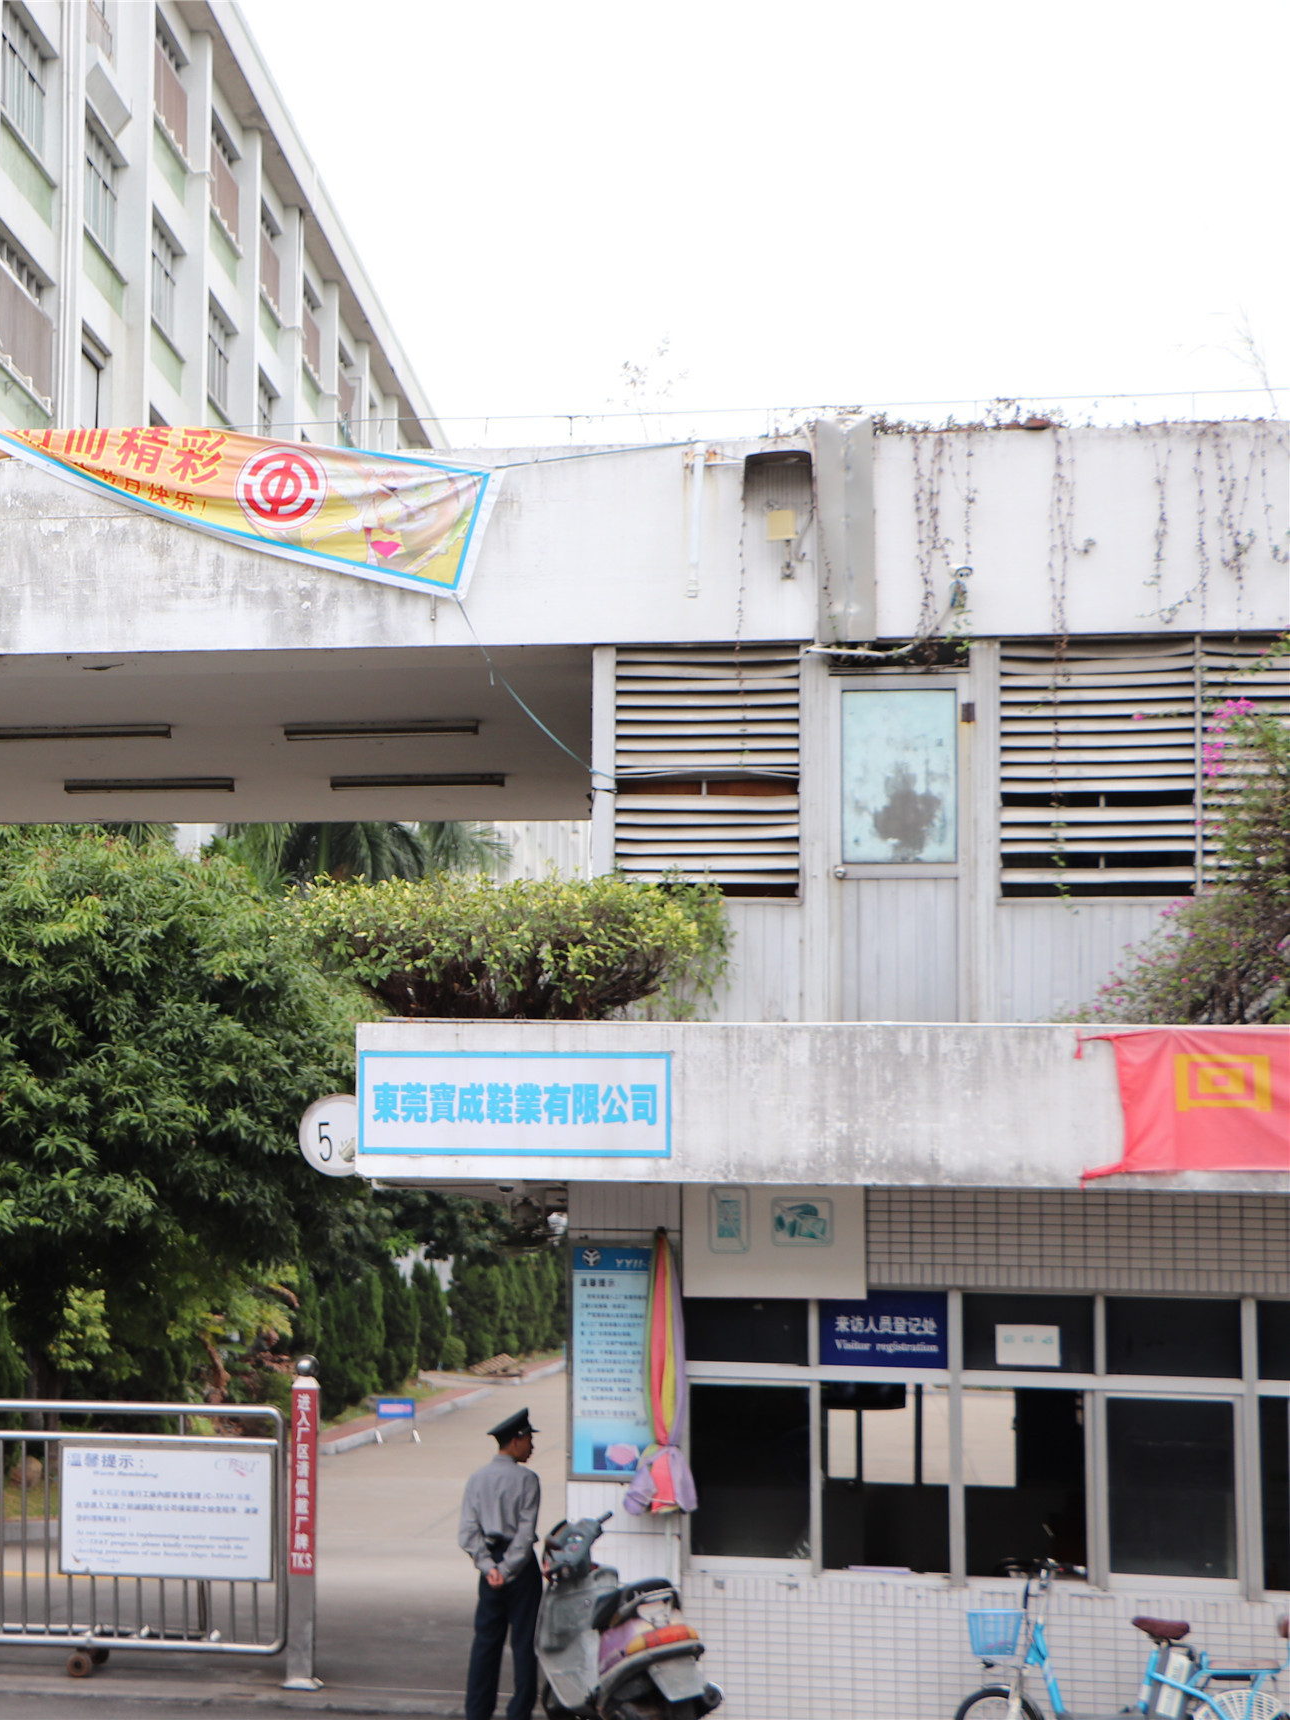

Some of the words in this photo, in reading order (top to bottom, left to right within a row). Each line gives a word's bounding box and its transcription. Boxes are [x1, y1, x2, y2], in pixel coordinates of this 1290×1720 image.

[372, 1082, 658, 1126] 東莞寶成鞋業有限公司
[316, 1121, 333, 1161] 5
[835, 1315, 938, 1336] 来访人员登记处
[835, 1339, 871, 1350] Visitor
[875, 1341, 939, 1354] registration
[291, 1552, 312, 1568] TKS
